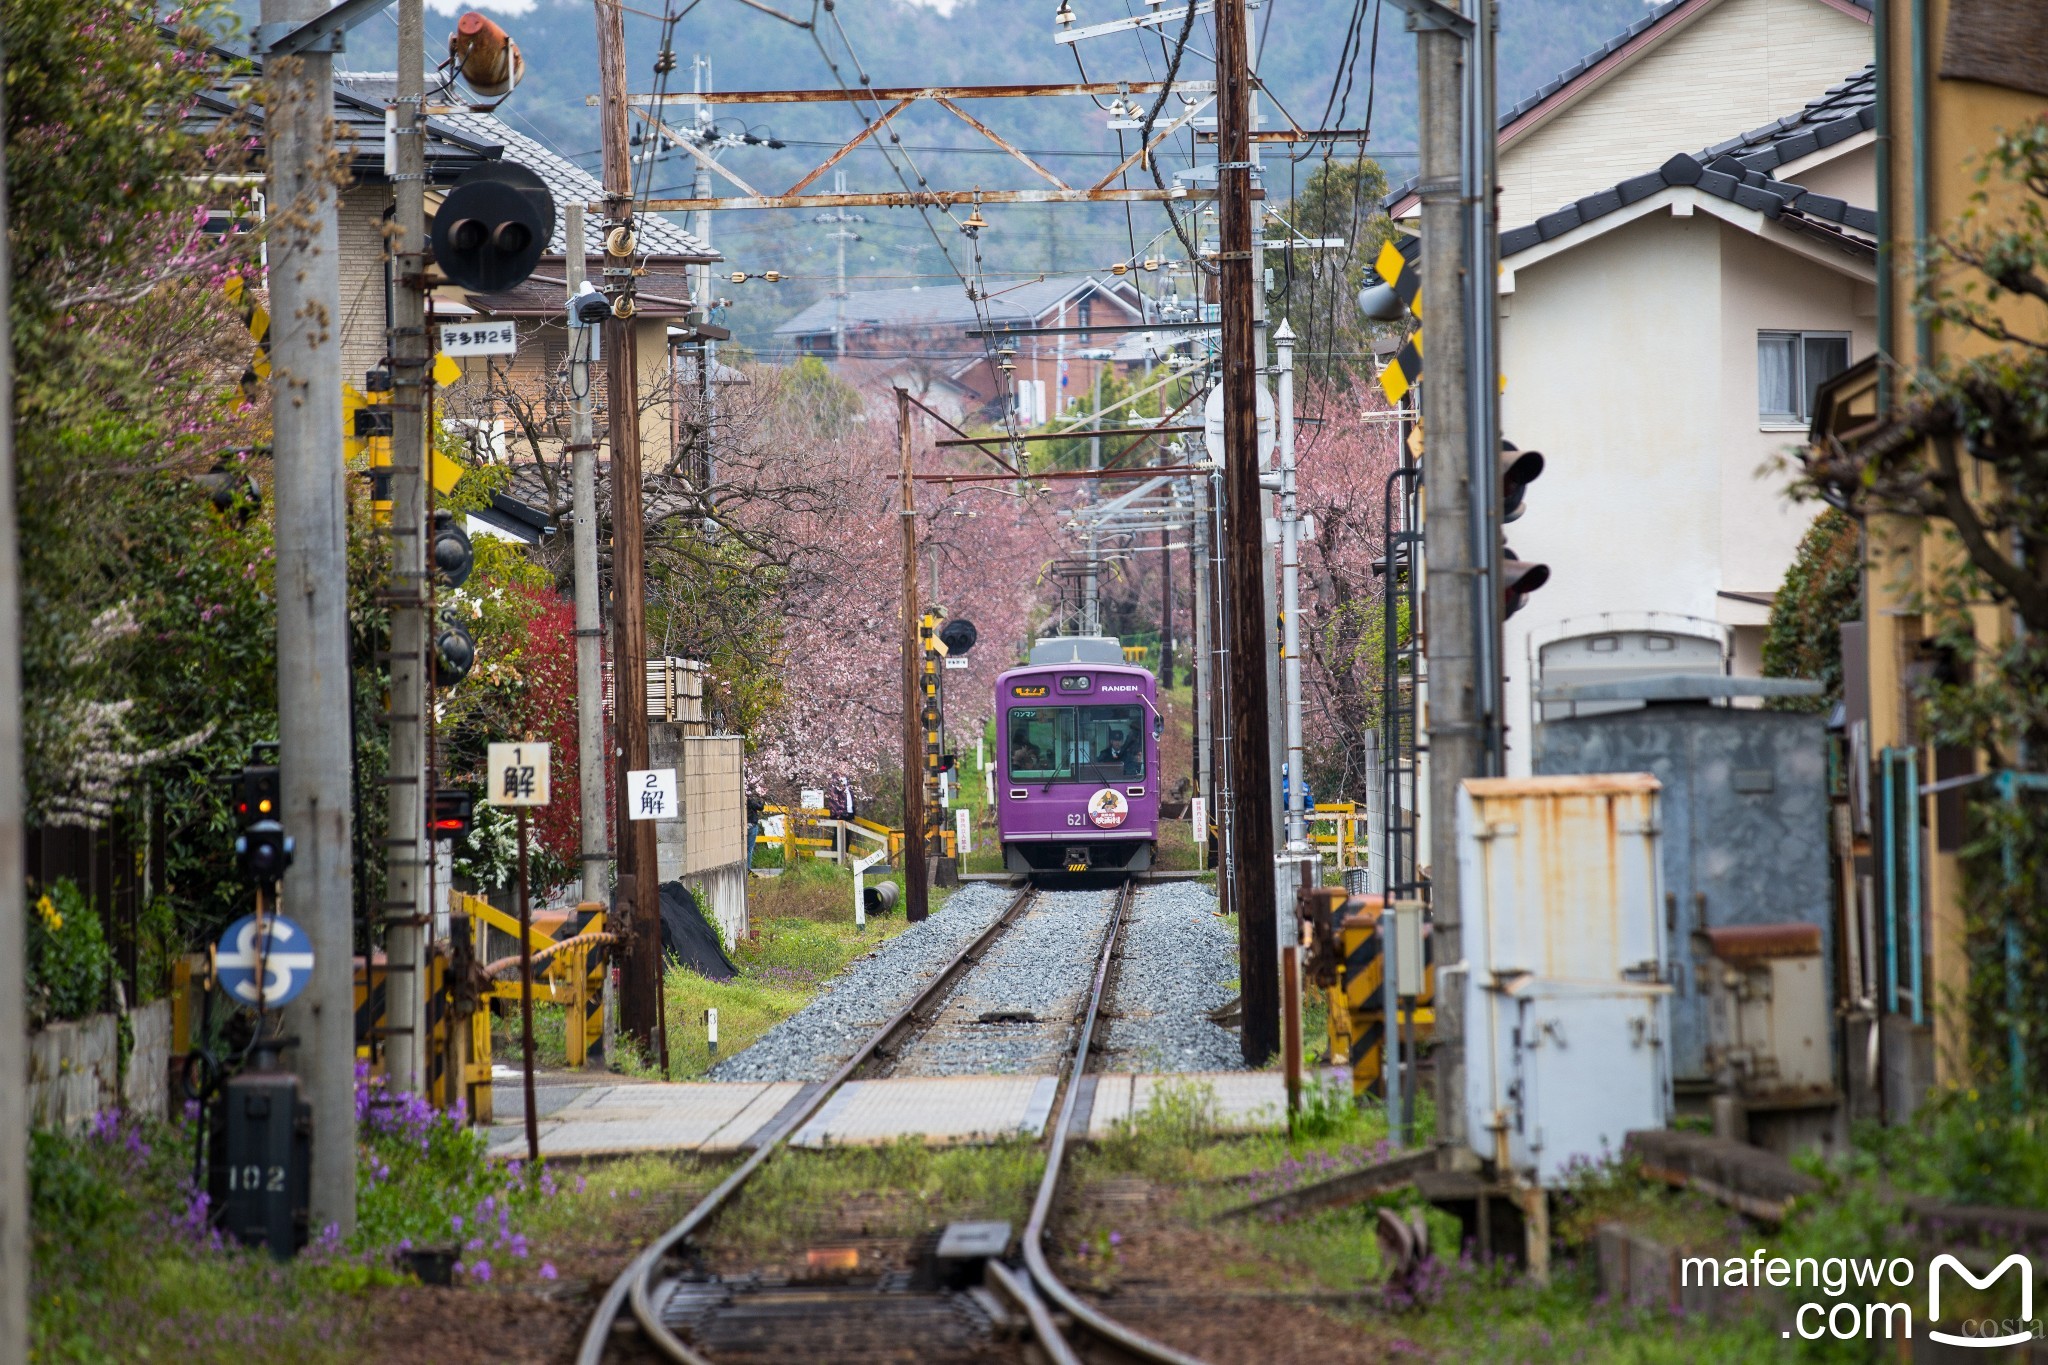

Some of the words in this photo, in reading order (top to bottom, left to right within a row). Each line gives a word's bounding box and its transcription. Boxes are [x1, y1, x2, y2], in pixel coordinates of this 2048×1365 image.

[443, 329, 512, 346] 宇多野2号
[512, 747, 522, 765] 1
[503, 766, 535, 798] 解
[645, 773, 657, 788] 2
[640, 790, 665, 815] 解
[1067, 814, 1086, 826] 621
[229, 1165, 286, 1191] 102
